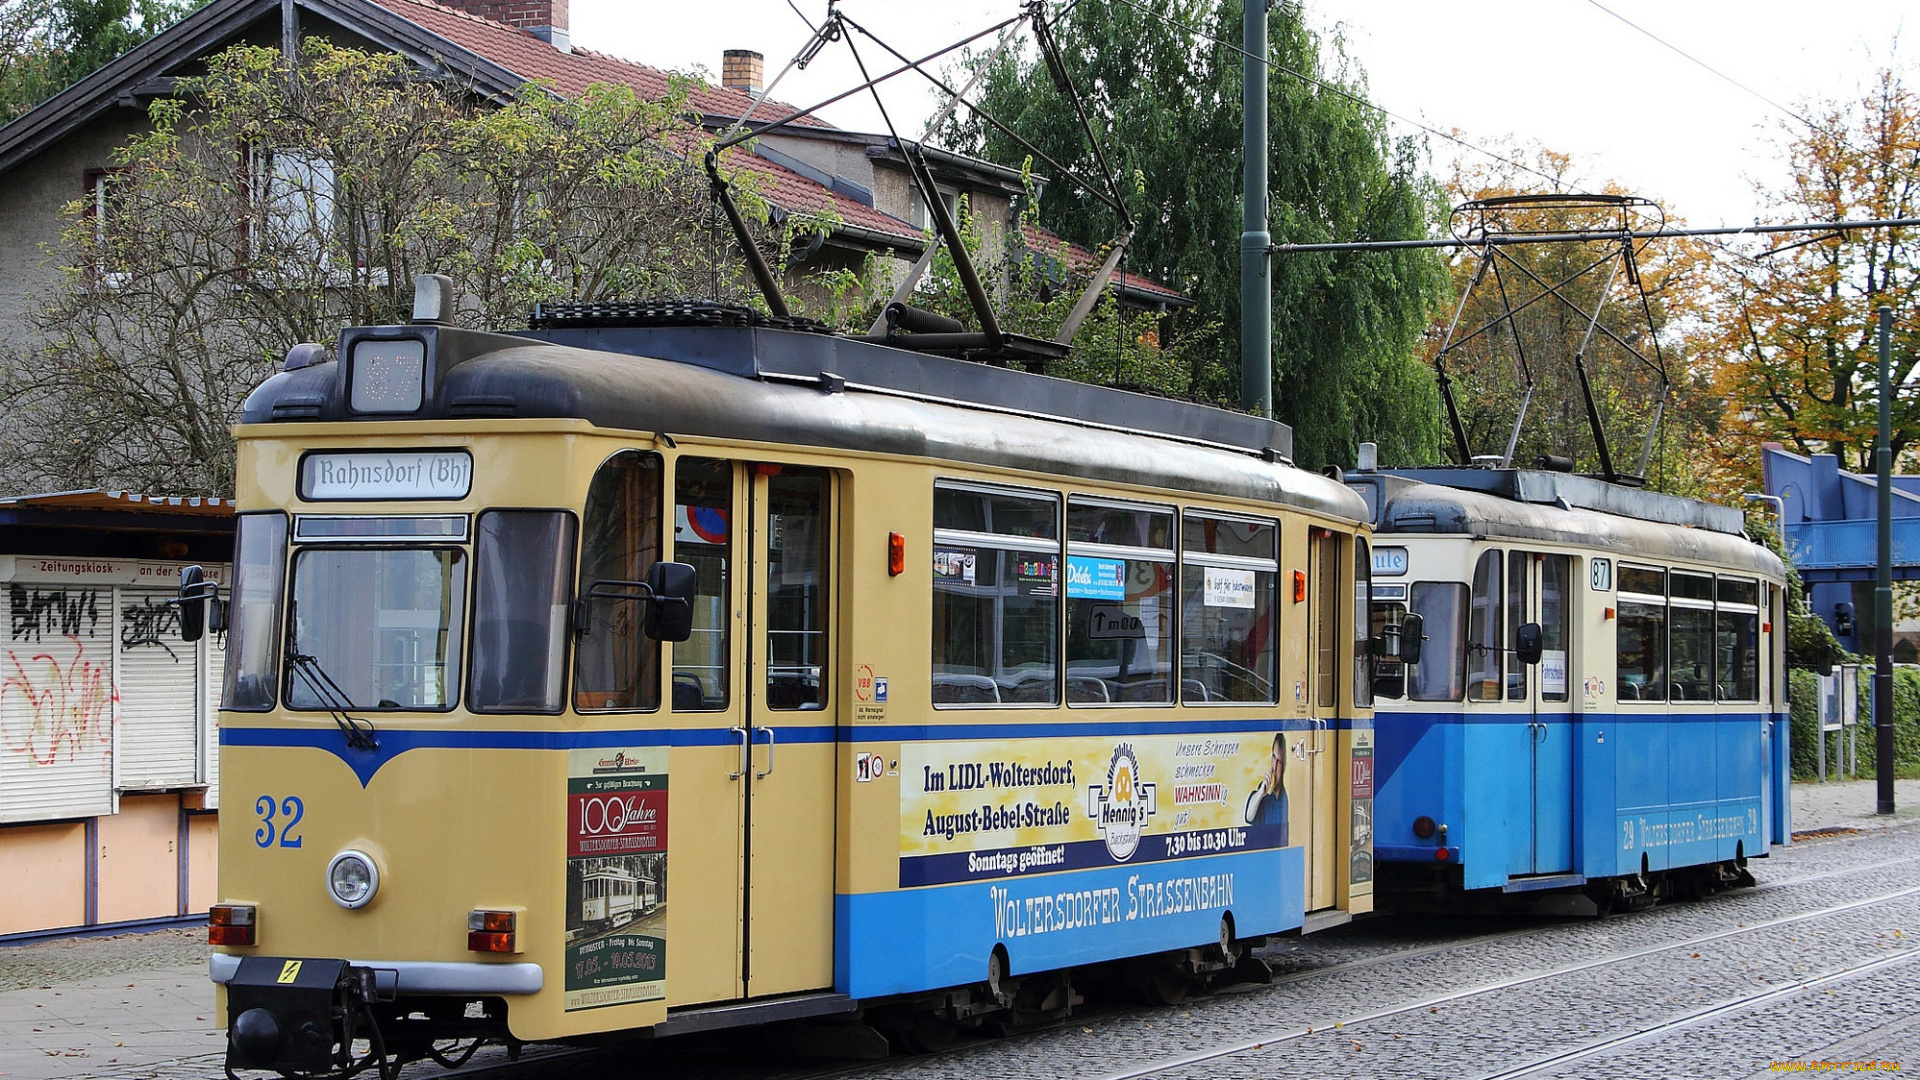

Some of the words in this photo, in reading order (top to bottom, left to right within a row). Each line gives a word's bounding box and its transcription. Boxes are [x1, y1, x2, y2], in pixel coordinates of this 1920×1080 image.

[365, 356, 421, 400] 87
[321, 458, 422, 489] Rahnsdorf
[40, 561, 113, 576] Zeitungskiosk
[140, 567, 152, 576] an
[156, 565, 172, 577] der
[1372, 550, 1402, 568] ule
[1592, 561, 1607, 588] 87
[858, 678, 871, 688] VBB
[1175, 741, 1201, 757] Unsere
[1203, 739, 1240, 758] Schrippen
[923, 765, 945, 792] Im
[948, 760, 1076, 791] LIDL-Woltersdorf,
[1175, 763, 1216, 779] schmecken
[255, 795, 304, 848] 32
[579, 796, 625, 835] 100
[622, 795, 656, 827] Jahre
[923, 801, 1070, 841] August-Bebel-Straße
[1174, 808, 1192, 831] gut!
[1623, 820, 1635, 850] 29
[1639, 817, 1695, 848] WOLTERSDORFER
[1697, 813, 1745, 842] STRASSENBAHN
[1748, 808, 1757, 835] 29
[1166, 835, 1185, 857] 7.30
[1187, 831, 1201, 852] bis
[1203, 831, 1227, 851] 10.30
[1228, 828, 1247, 847] Uhr
[968, 852, 1018, 873] Sonntags
[1019, 845, 1065, 873] geöffnet!
[990, 885, 1121, 940] WOLTERSDORFER
[1125, 873, 1235, 922] STRASSENBAHN
[609, 938, 625, 948] Freitag
[635, 938, 654, 950] Sonntag
[575, 956, 601, 980] 17.05.
[611, 951, 657, 971] 19.05.2013
